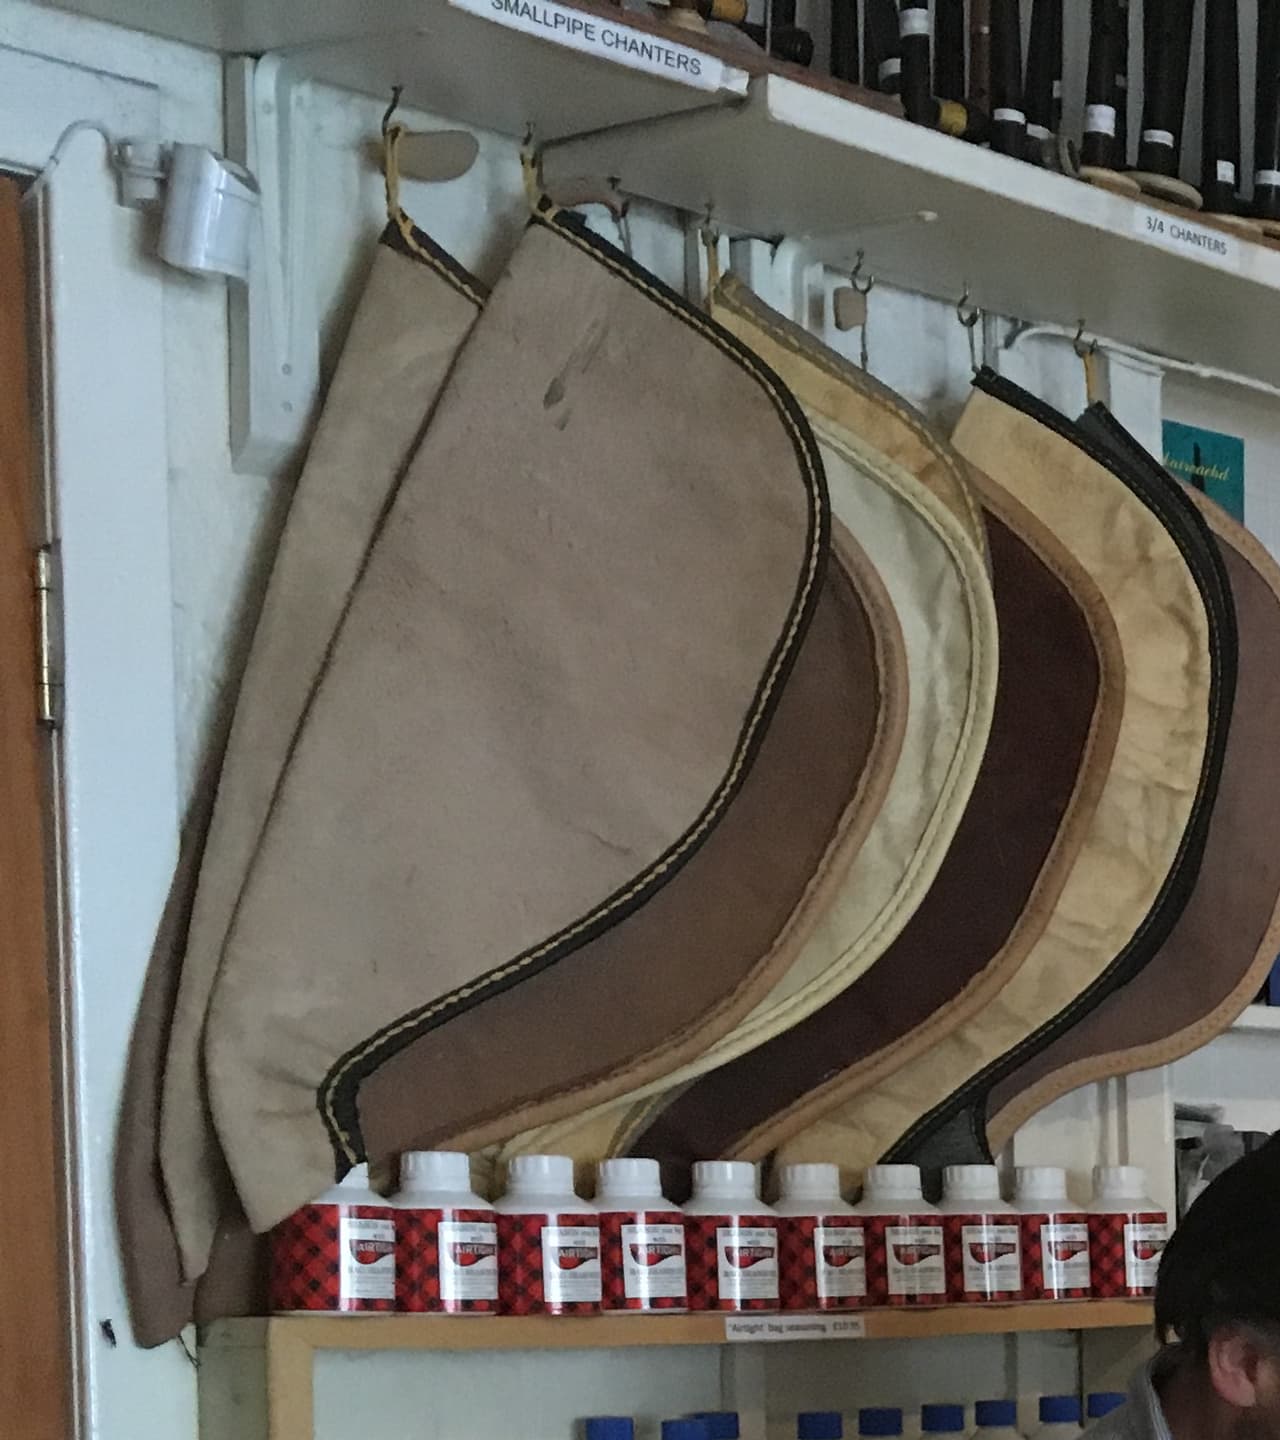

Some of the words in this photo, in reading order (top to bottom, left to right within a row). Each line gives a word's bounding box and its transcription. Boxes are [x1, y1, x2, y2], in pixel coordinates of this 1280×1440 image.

[601, 30, 702, 76] CHANTERS
[1145, 216, 1165, 235] 3/4
[1170, 224, 1228, 256] CHANTERS
